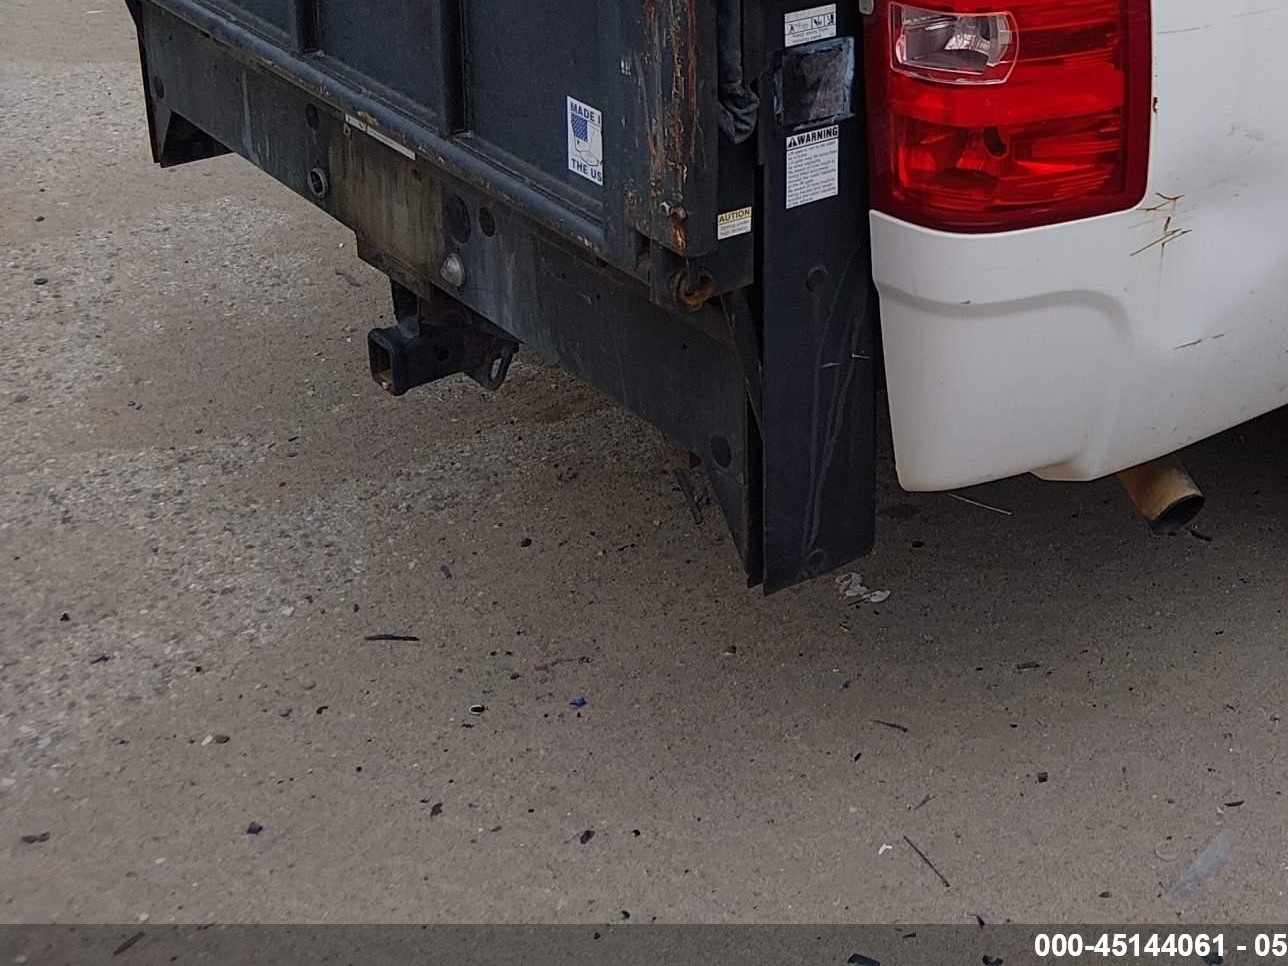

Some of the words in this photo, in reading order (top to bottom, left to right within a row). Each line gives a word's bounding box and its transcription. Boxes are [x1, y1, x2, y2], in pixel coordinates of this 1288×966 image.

[570, 101, 596, 122] MADE
[797, 126, 838, 146] WARNING
[571, 158, 588, 174] THE
